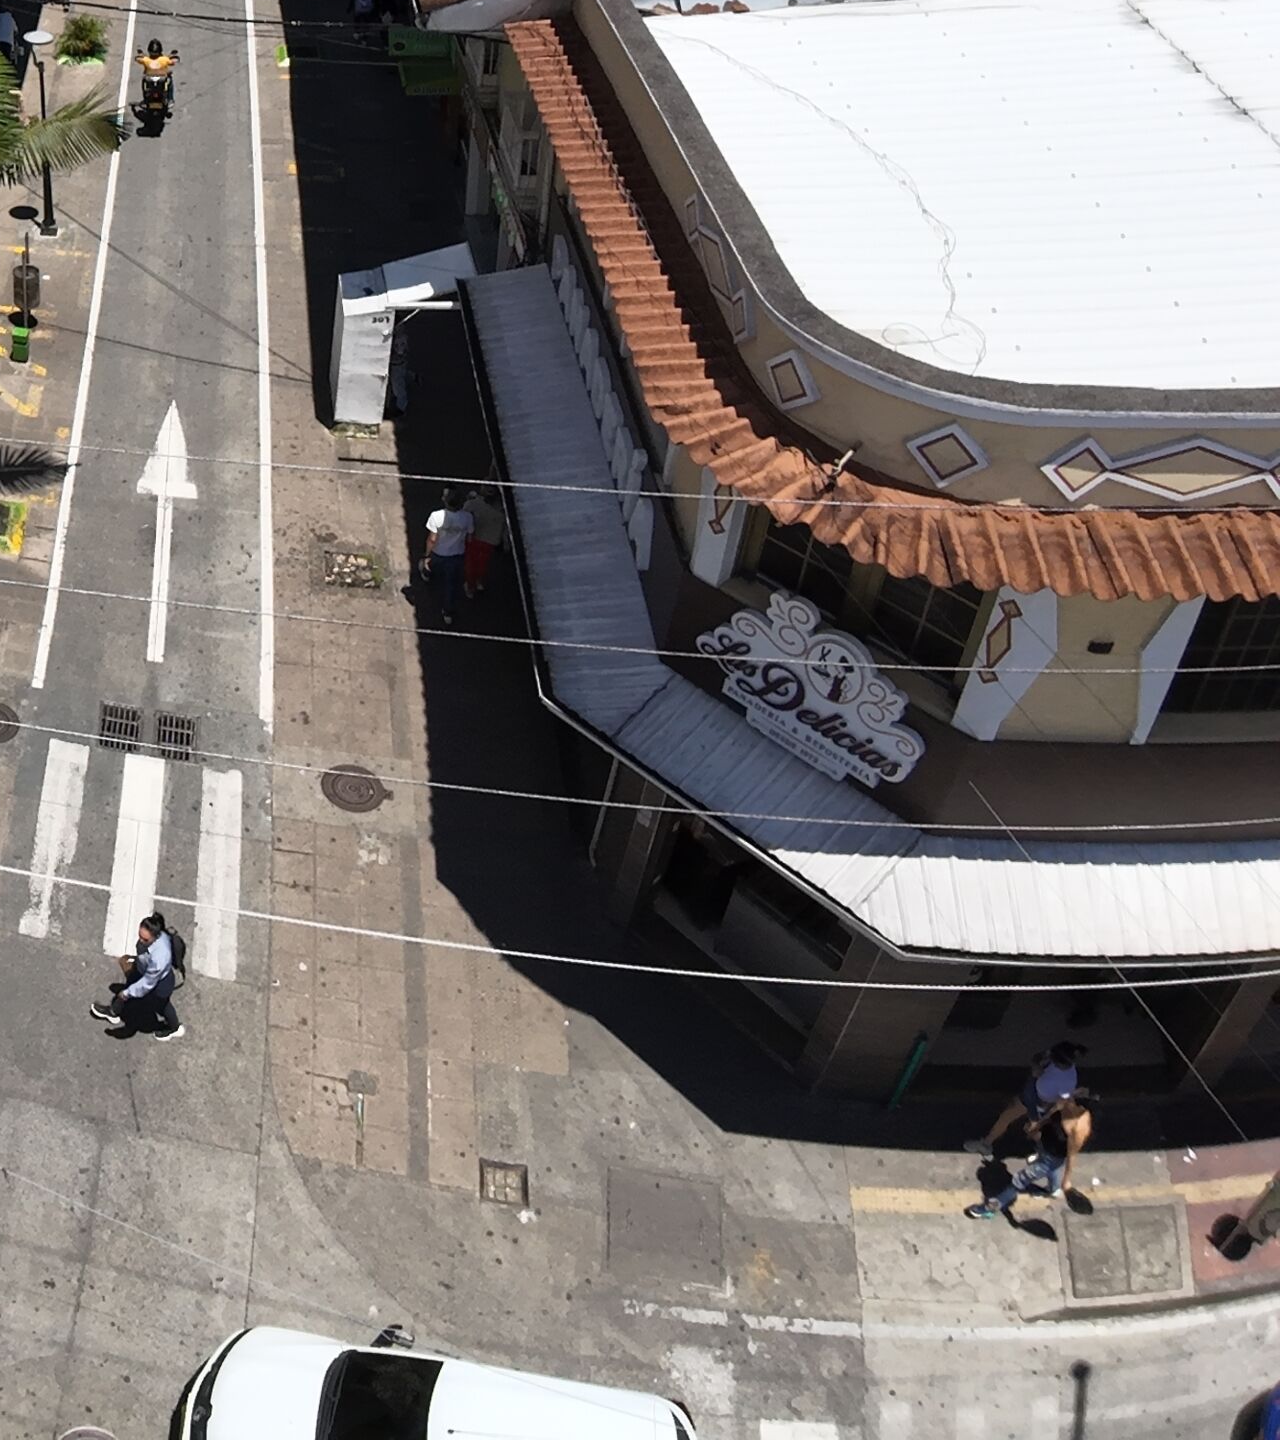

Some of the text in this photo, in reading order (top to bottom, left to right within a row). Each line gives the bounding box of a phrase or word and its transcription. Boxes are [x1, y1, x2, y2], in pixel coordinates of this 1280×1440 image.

[700, 633, 903, 778] Las Delicias
[727, 686, 787, 728] PANADERÍA
[804, 734, 872, 782] REPOSTERÍA
[768, 729, 797, 751] DESDE
